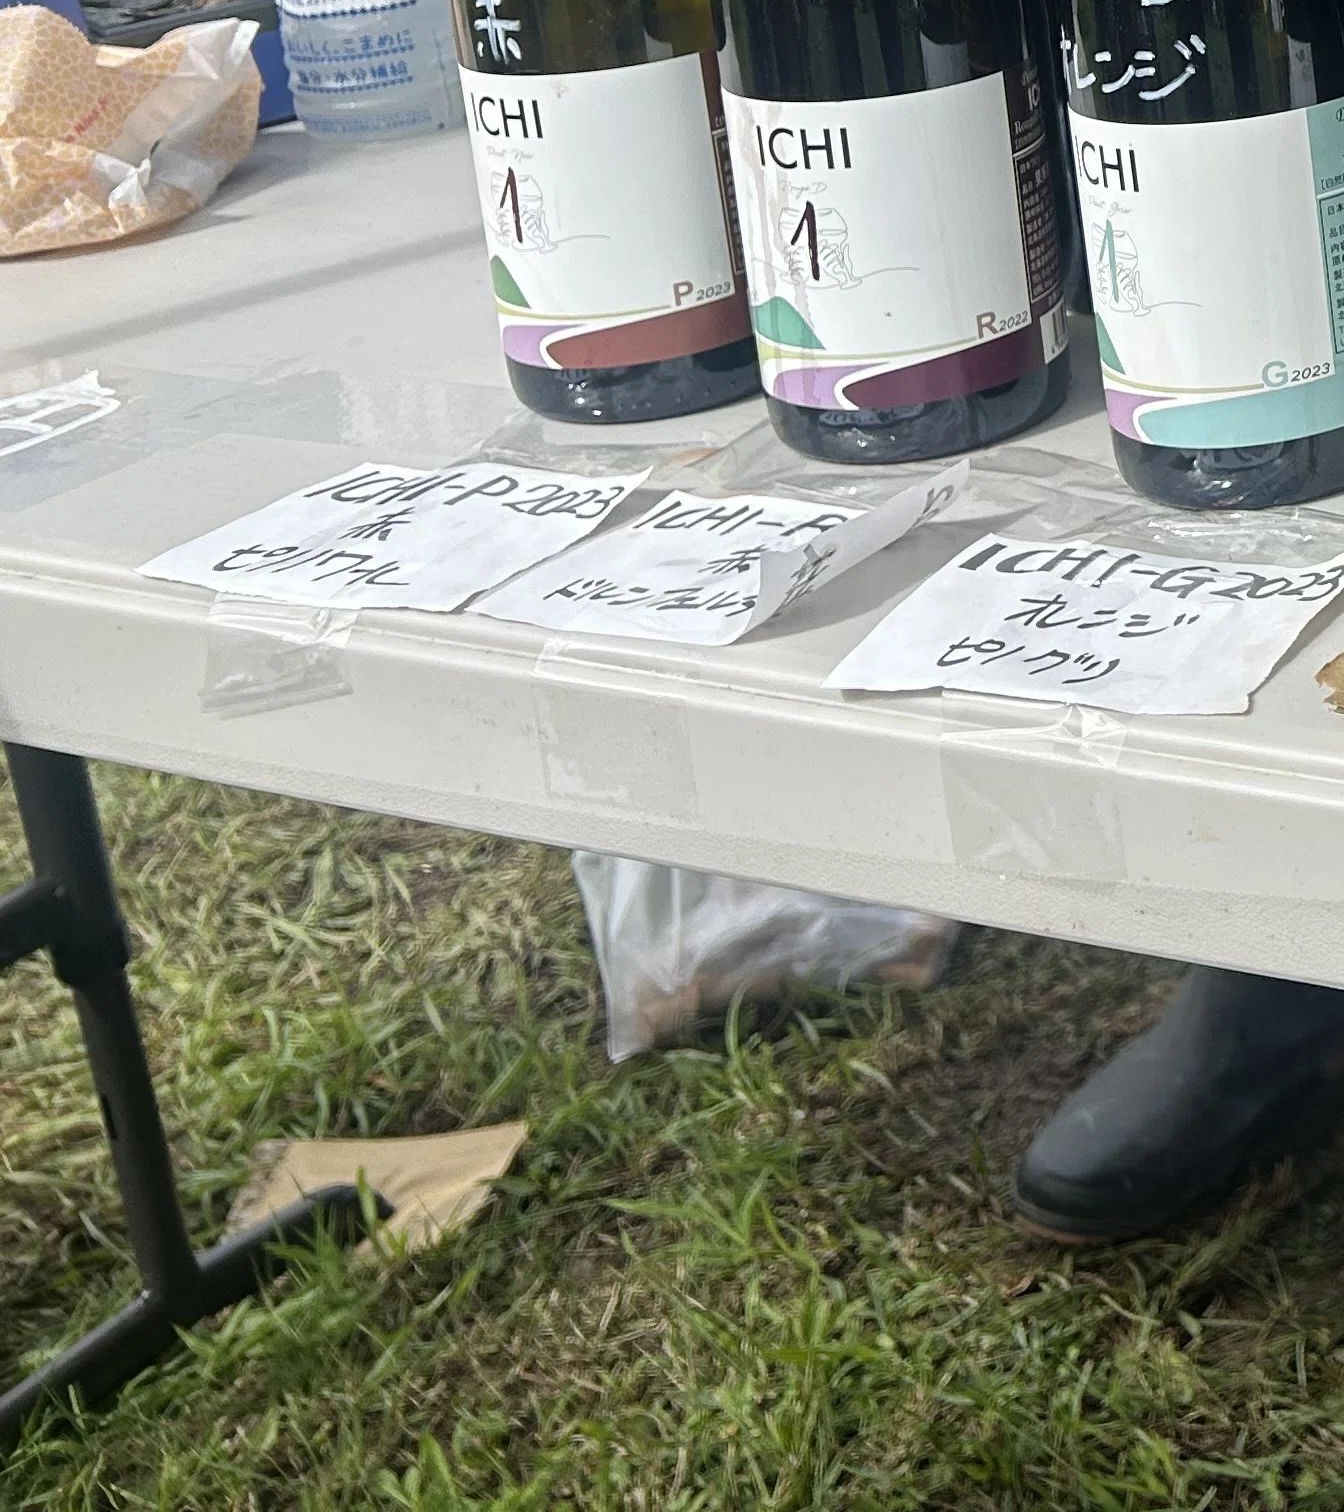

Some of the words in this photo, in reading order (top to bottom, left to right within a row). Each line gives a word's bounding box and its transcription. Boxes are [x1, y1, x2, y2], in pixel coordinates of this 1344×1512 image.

[470, 92, 545, 139] ICHI
[756, 125, 852, 170] ICHI
[1074, 135, 1140, 193] ICHI
[671, 280, 694, 307] P
[696, 281, 732, 302] 2023
[976, 312, 998, 338] R
[999, 310, 1029, 332] 2022
[1262, 361, 1289, 388] G
[1290, 362, 1331, 383] 2023
[339, 506, 416, 541] 赤
[1003, 592, 1200, 638] オレンジ
